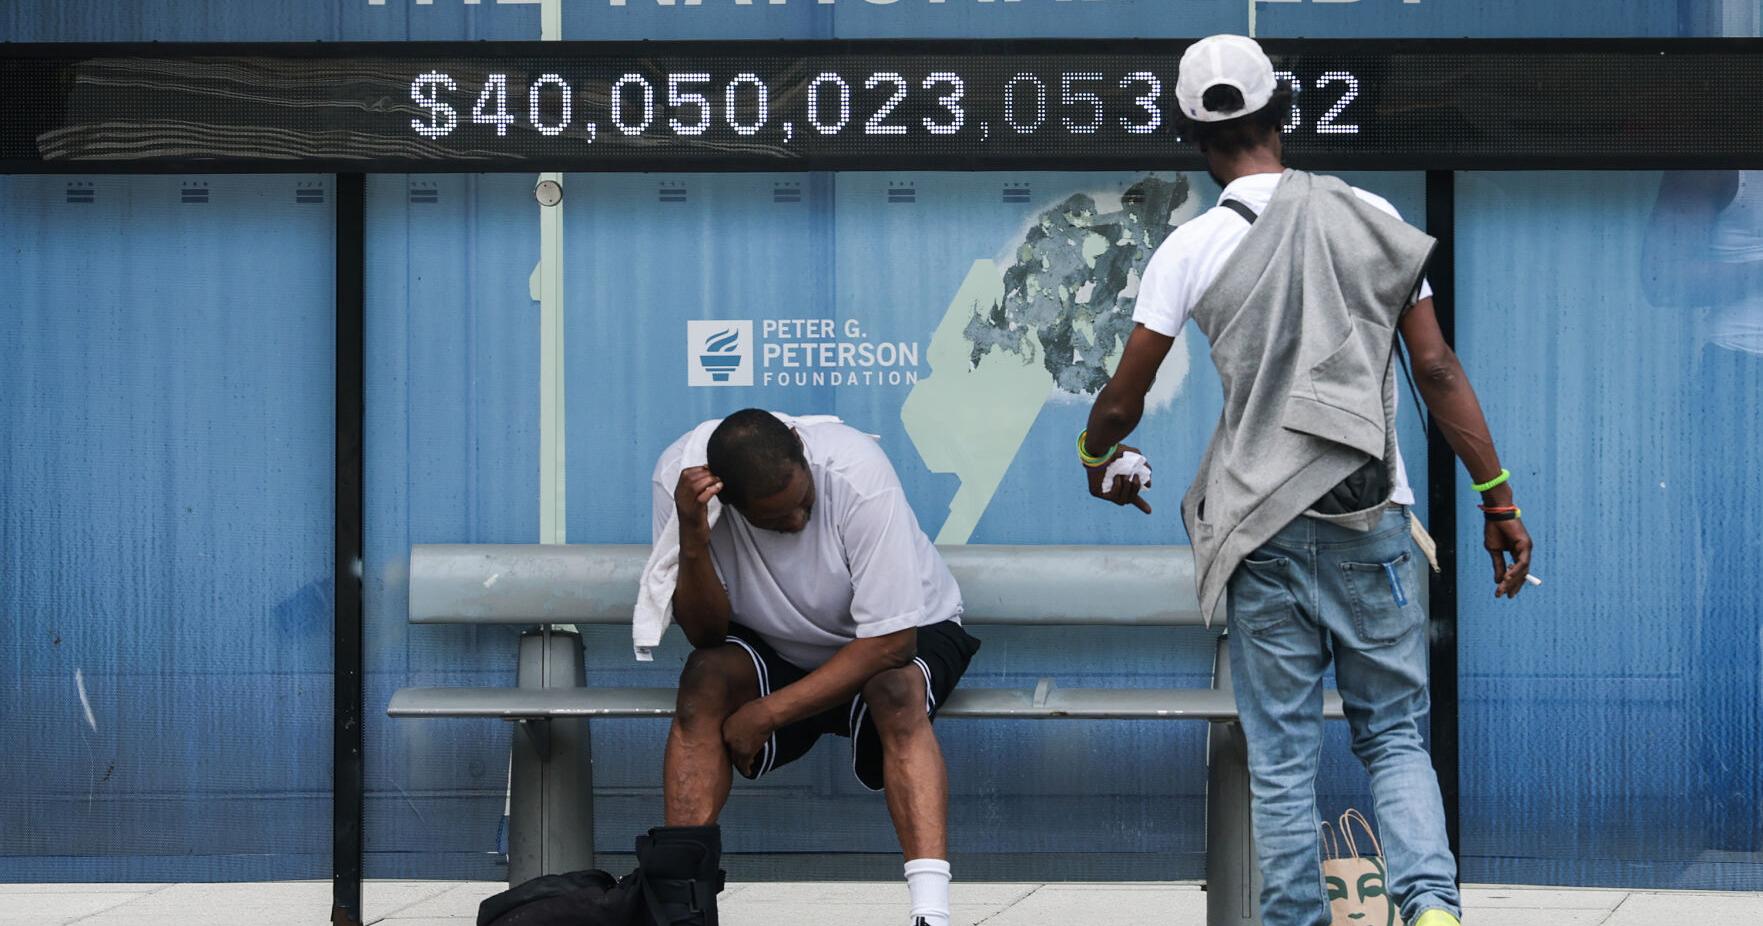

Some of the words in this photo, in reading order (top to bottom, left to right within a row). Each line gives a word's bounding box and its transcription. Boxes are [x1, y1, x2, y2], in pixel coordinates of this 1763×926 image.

[411, 70, 1359, 143] $40,050,023,0532
[763, 320, 835, 338] PETER
[845, 319, 867, 338] G.
[763, 342, 918, 367] PETERSON
[763, 371, 918, 386] FOUNDATION
